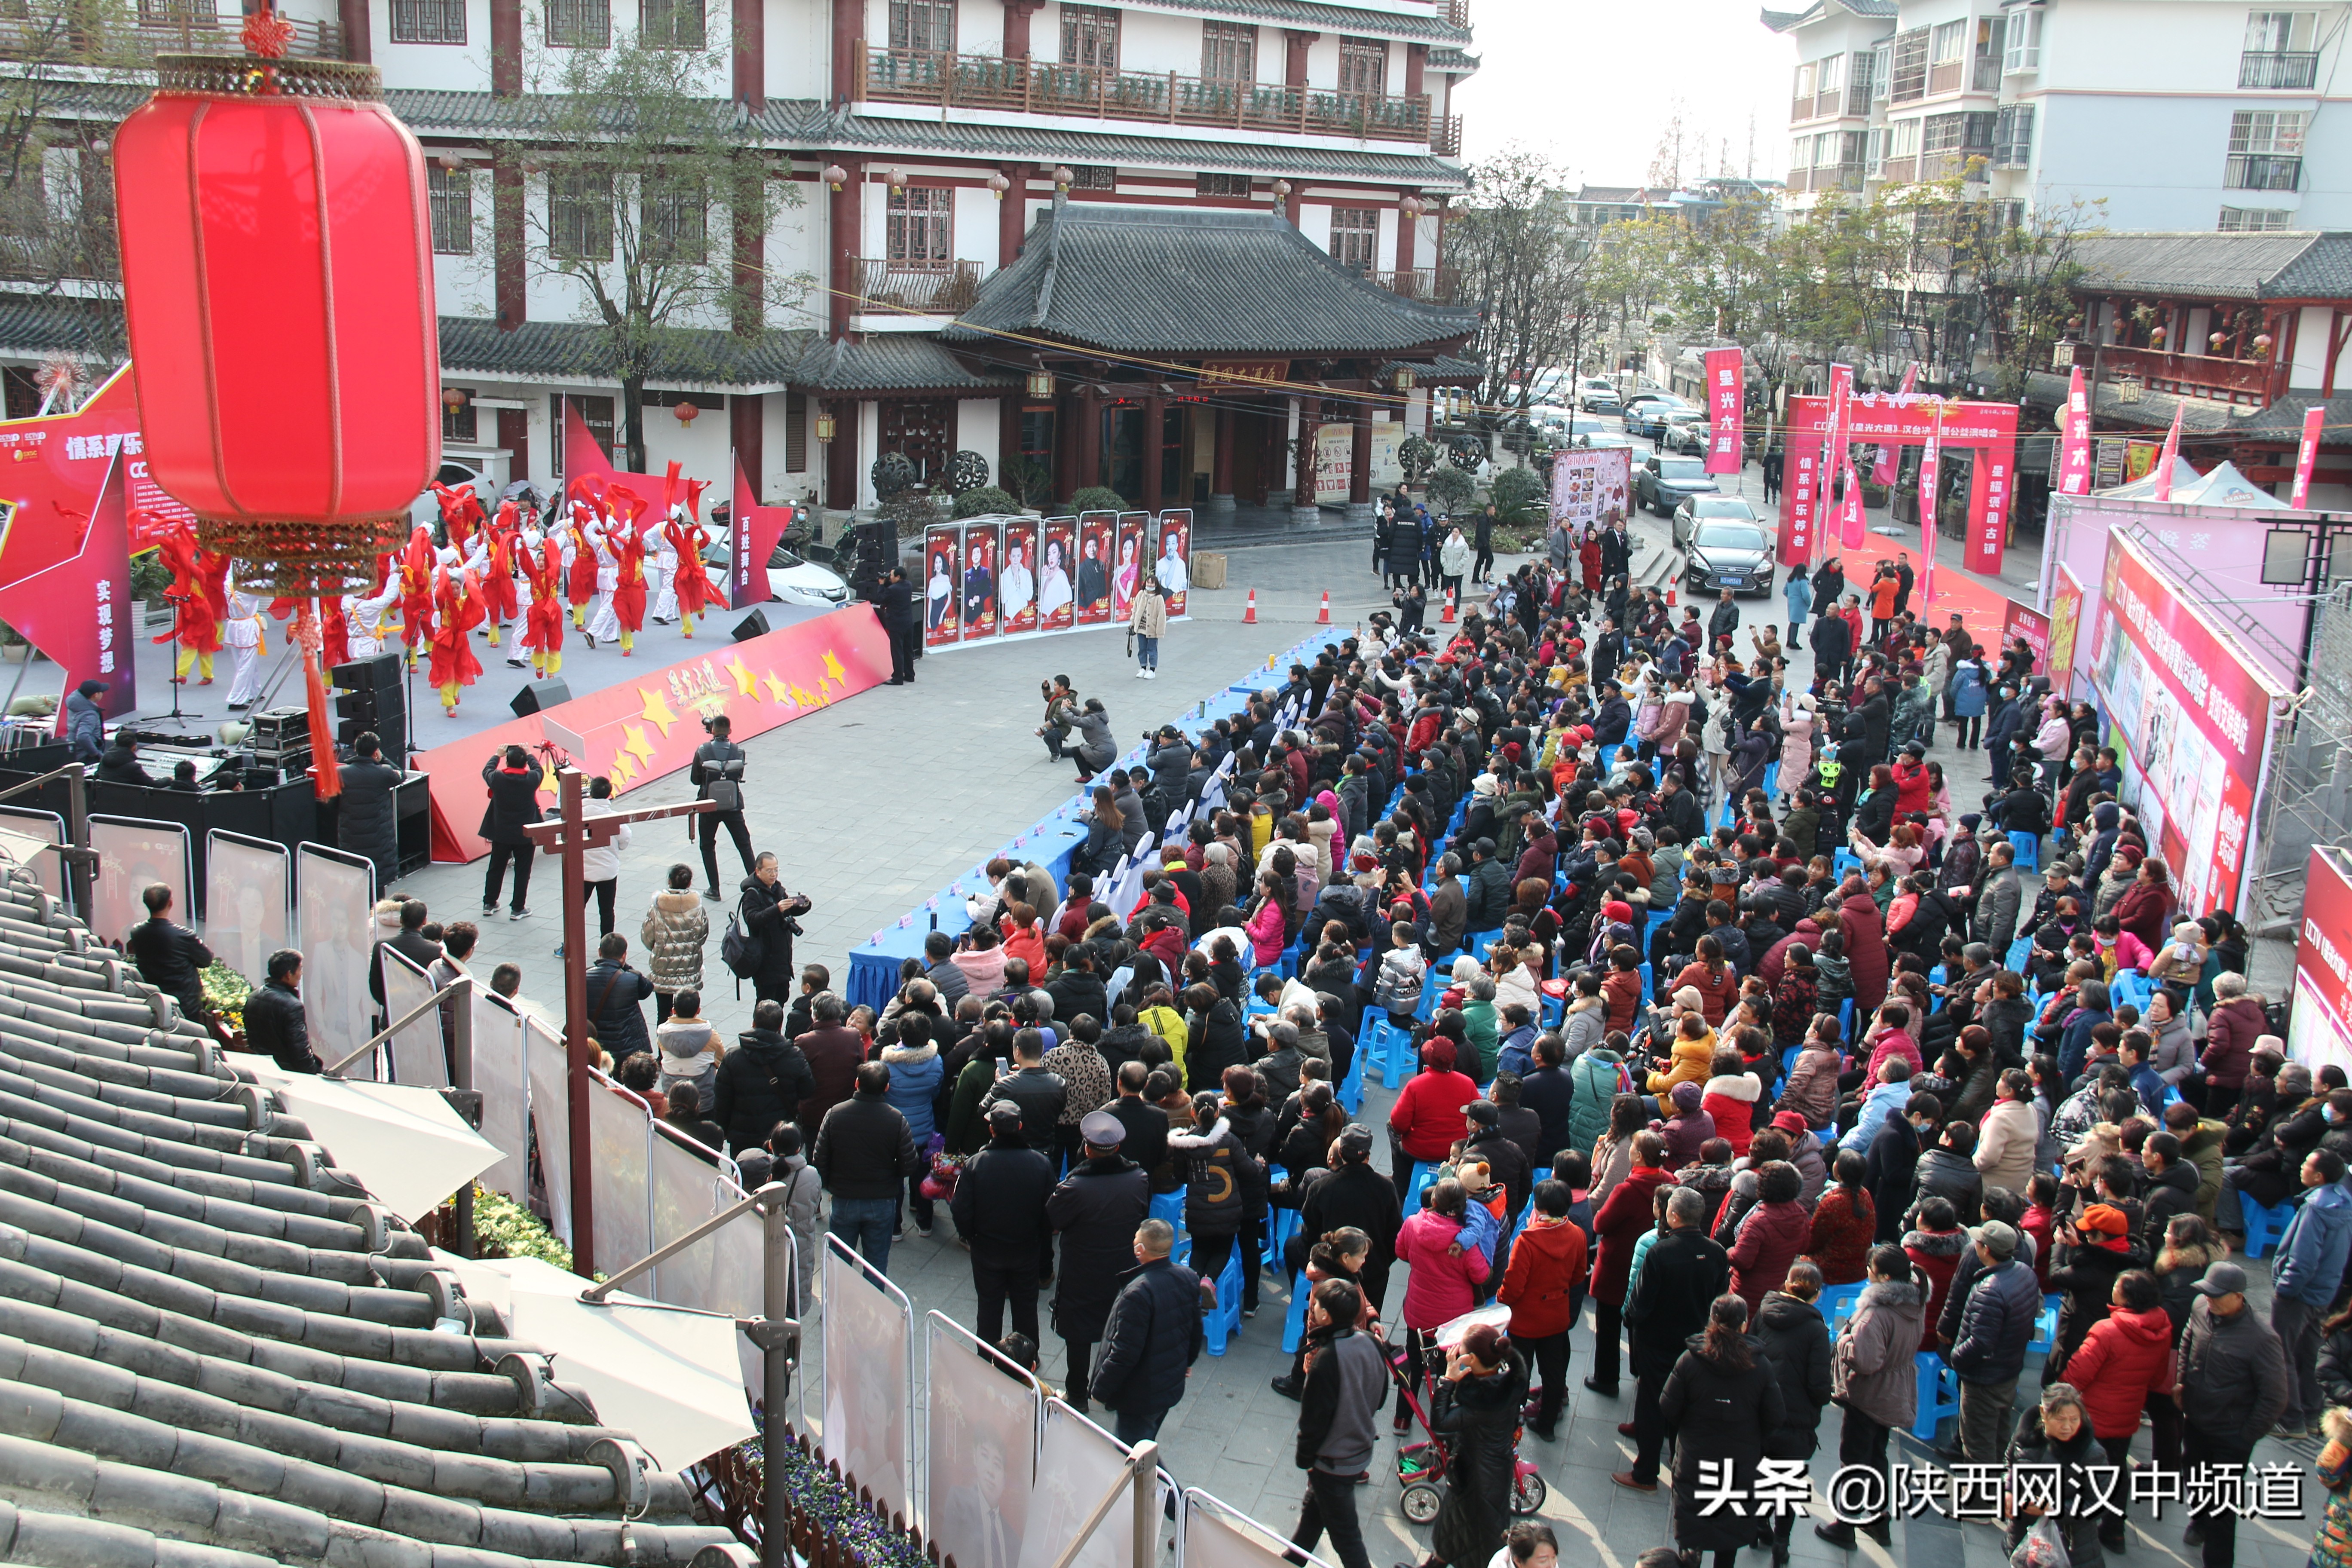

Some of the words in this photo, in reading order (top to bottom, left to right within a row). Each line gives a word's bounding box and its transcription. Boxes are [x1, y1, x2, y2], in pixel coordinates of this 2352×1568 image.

[1902, 424, 1998, 438] 汉台决暨公益演唱会
[2062, 392, 2087, 493] 星光大道
[1793, 457, 1812, 547] 情系康乐养老
[1983, 465, 2003, 554] 星耀褒国古镇
[740, 516, 750, 586] 百姓舞台
[96, 579, 115, 674] 实现梦想
